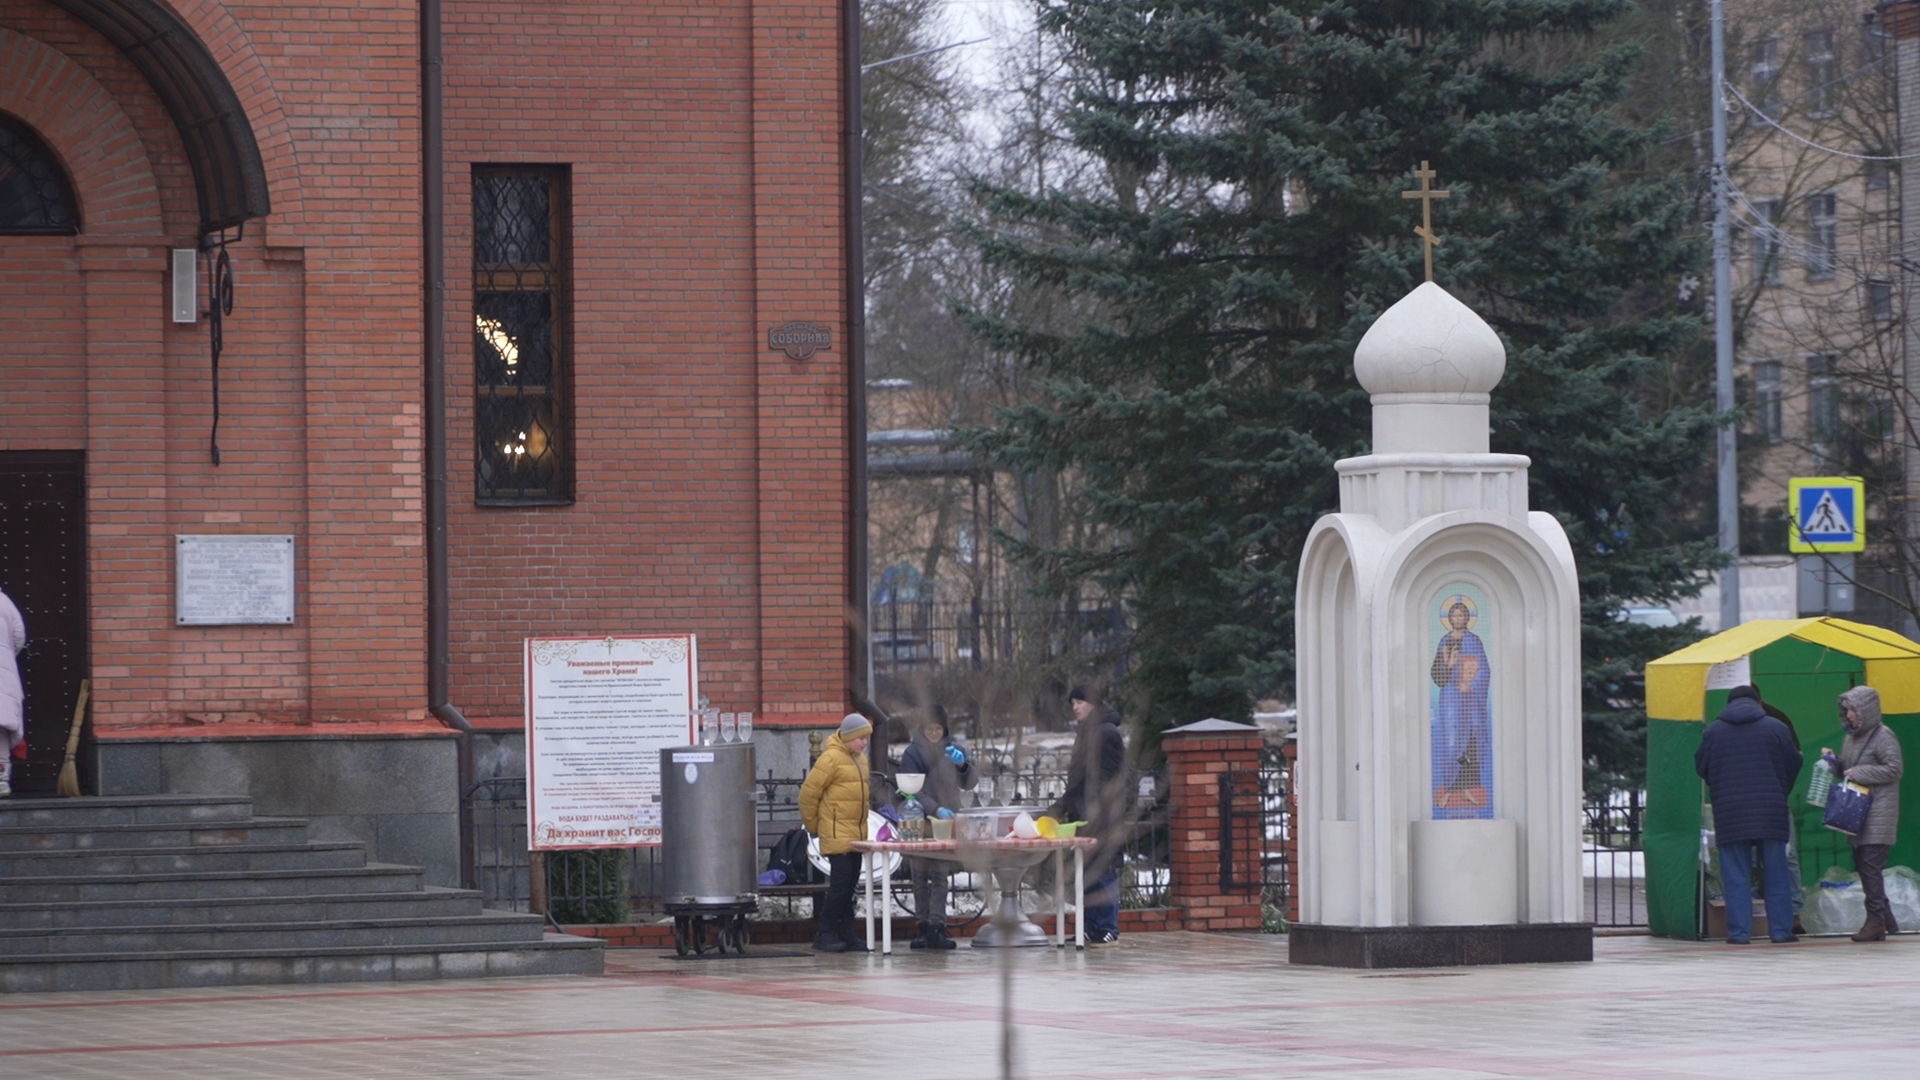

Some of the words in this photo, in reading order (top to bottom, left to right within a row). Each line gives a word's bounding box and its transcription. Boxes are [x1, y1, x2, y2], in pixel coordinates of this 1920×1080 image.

[771, 333, 829, 343] СОБОРНАЯ
[797, 346, 804, 357] 1
[566, 660, 611, 668] Уважаемые
[612, 660, 654, 668] прихожане
[612, 667, 638, 676] Храма!
[594, 814, 634, 822] РАЗДАВАТЬСЯ
[547, 828, 562, 839] Да
[564, 829, 606, 839] хранит
[607, 828, 627, 837] вас
[628, 826, 661, 837] Госпо
